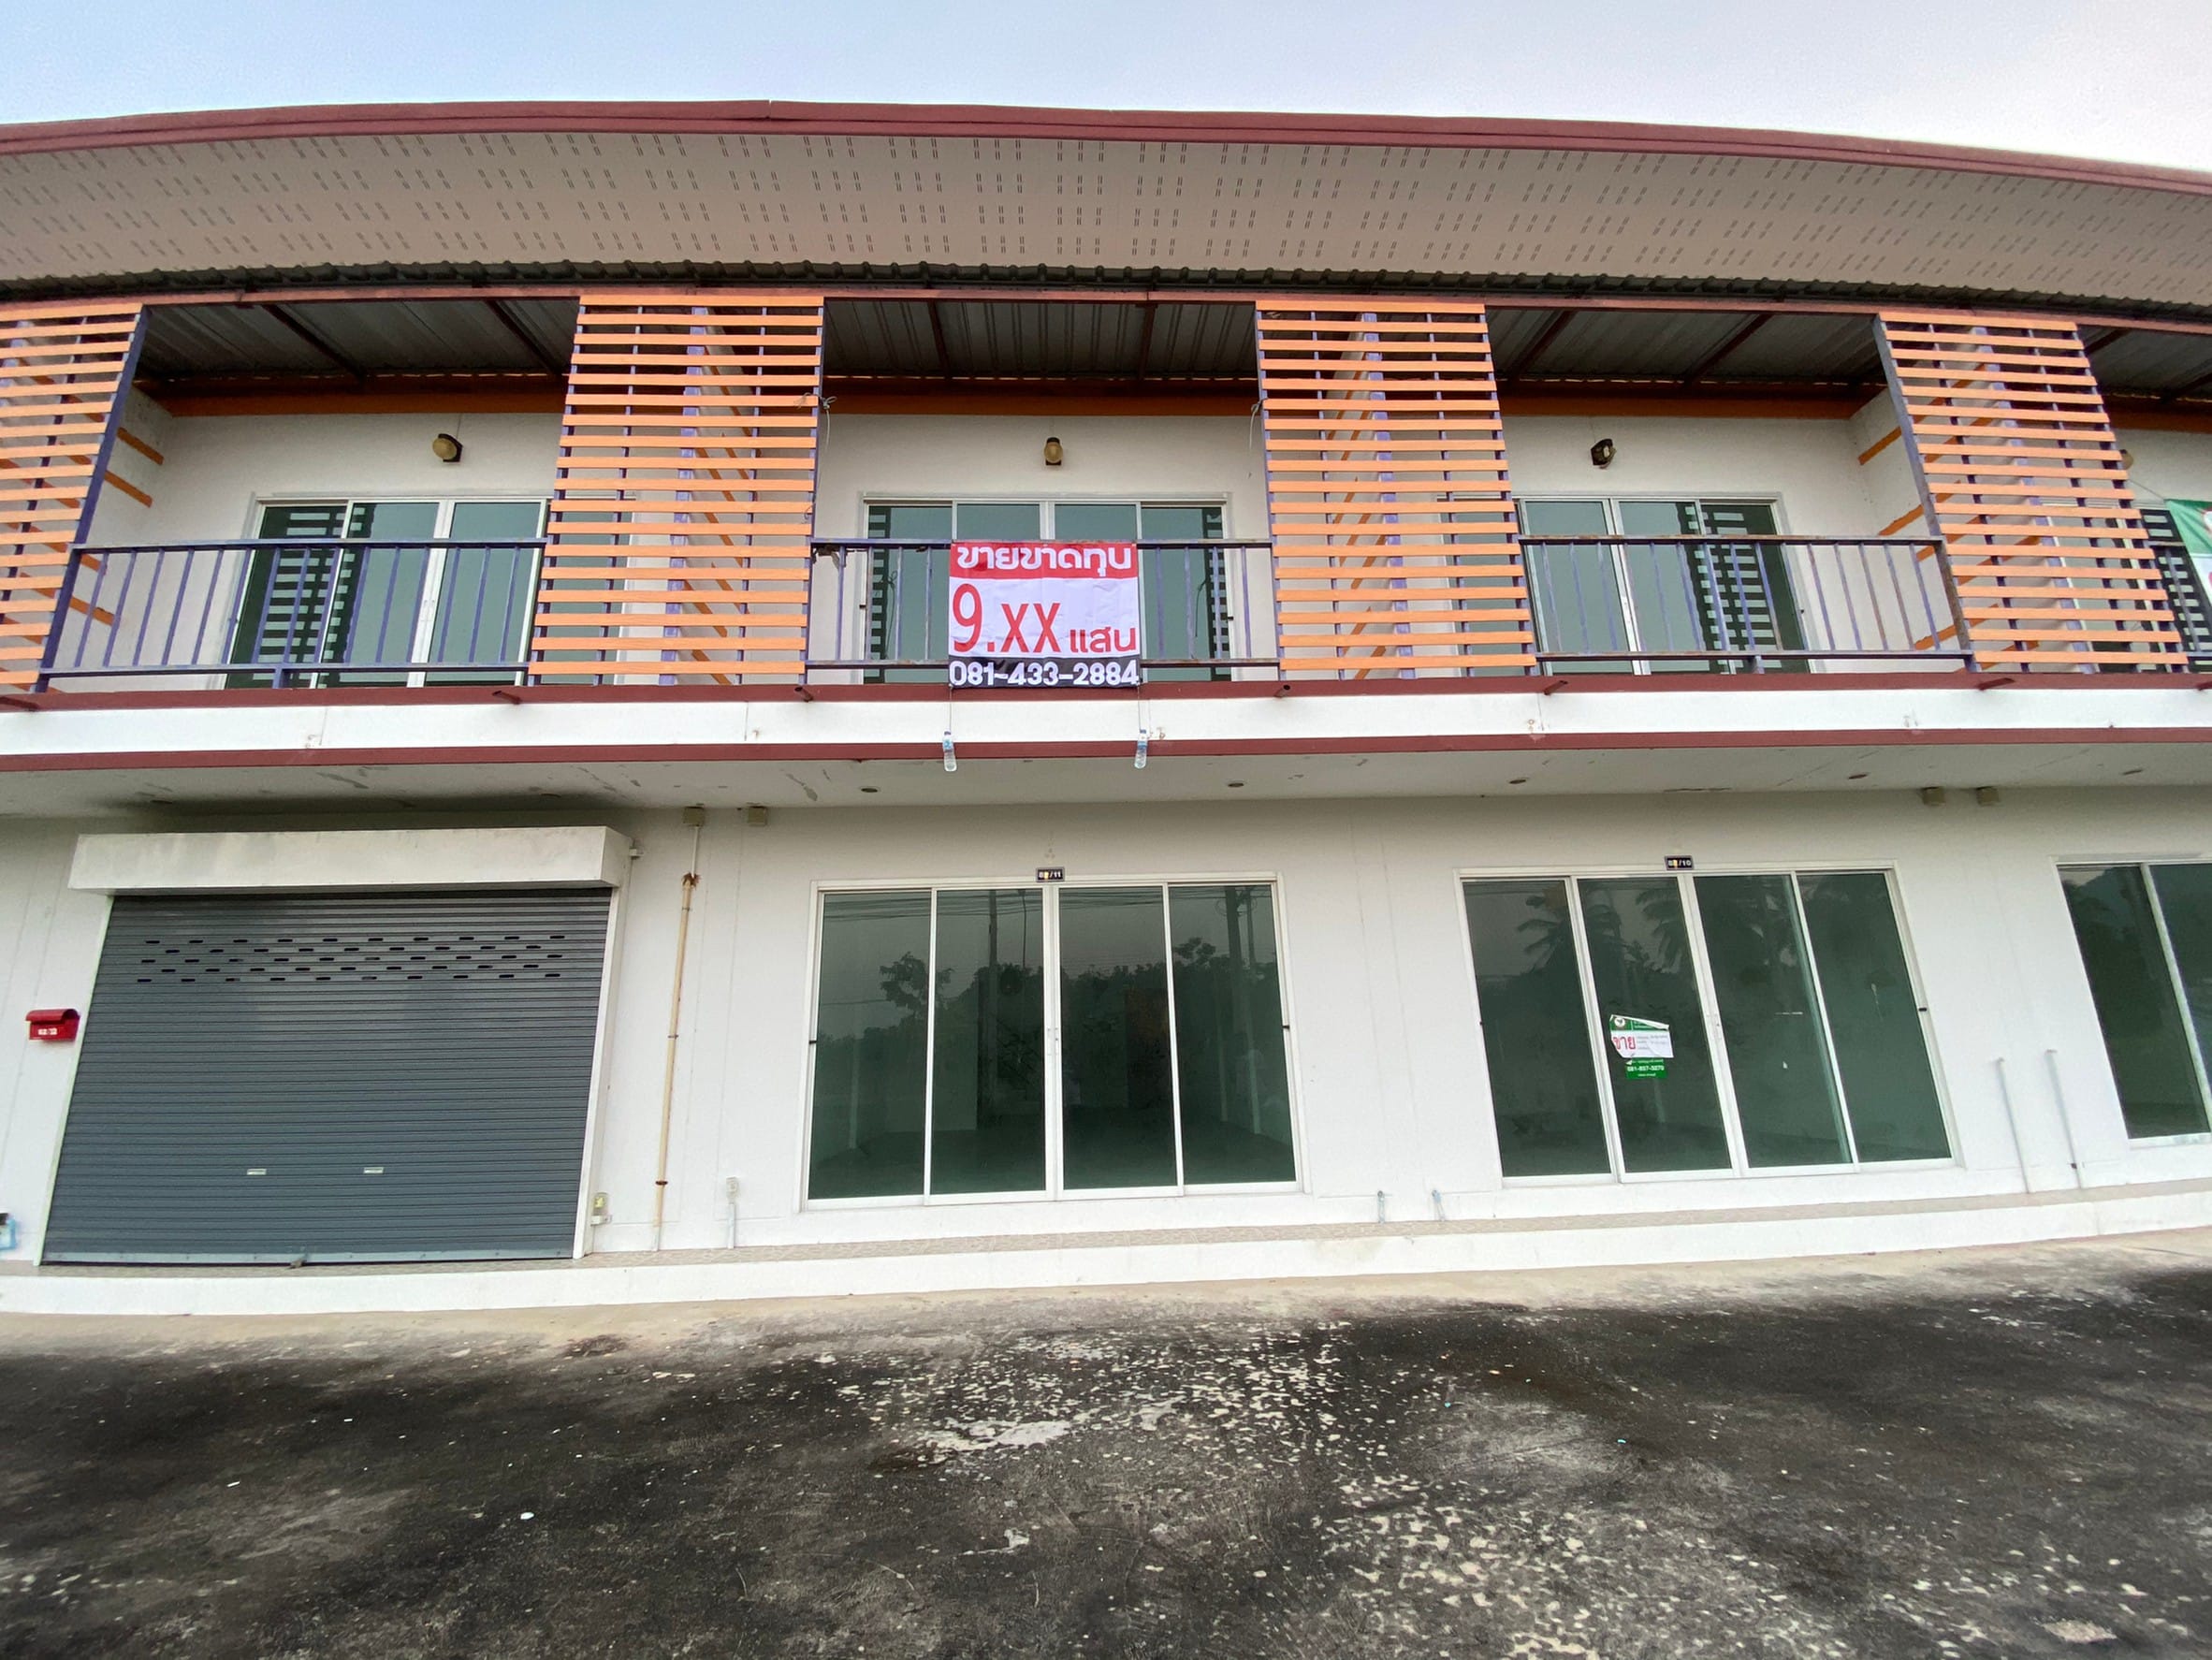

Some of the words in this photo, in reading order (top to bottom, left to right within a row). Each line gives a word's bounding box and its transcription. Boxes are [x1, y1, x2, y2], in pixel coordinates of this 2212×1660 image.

[956, 546, 1132, 577] ขายขาดทุน
[1070, 626, 1137, 653] แสน
[949, 660, 1140, 686] 081-433-2884
[1612, 1036, 1637, 1050] ขาย
